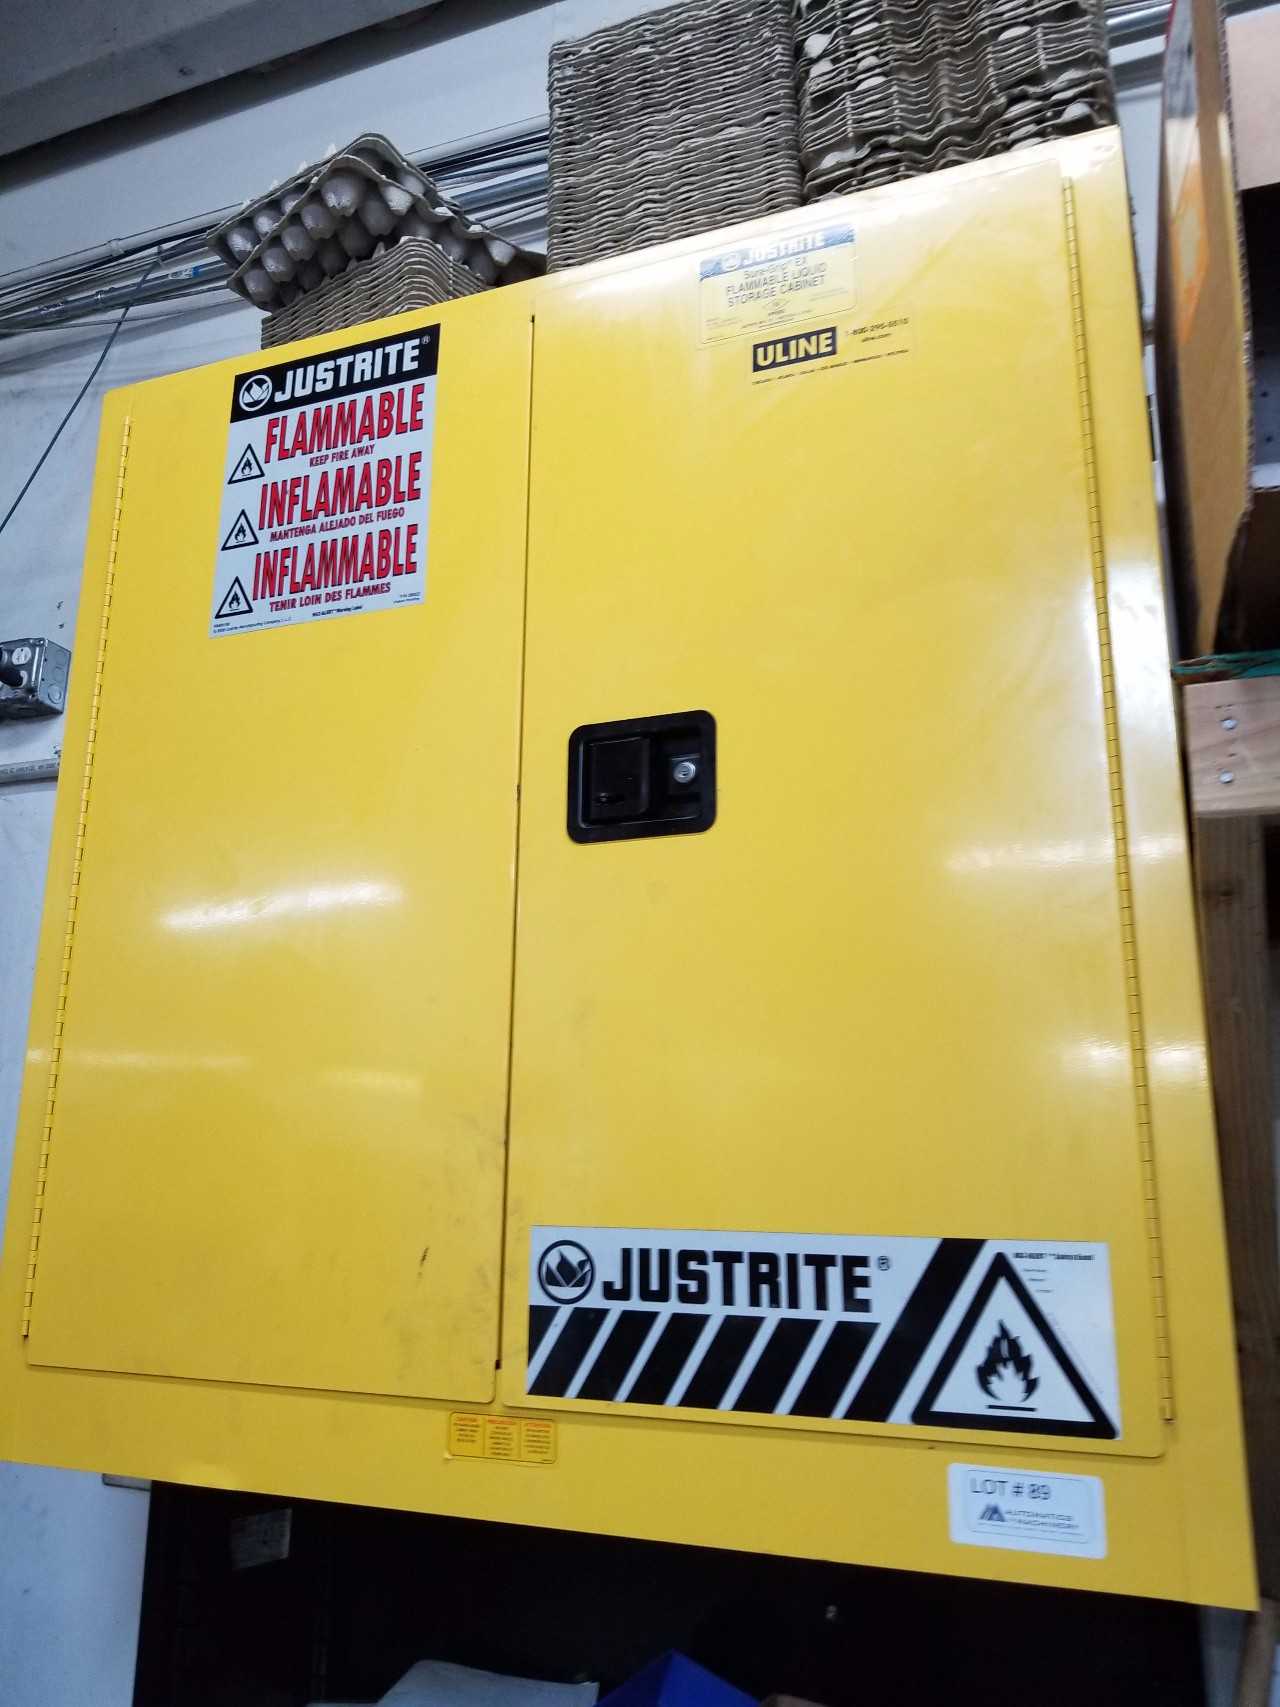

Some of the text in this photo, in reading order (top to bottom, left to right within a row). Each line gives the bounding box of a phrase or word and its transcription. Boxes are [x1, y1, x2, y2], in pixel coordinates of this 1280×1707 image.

[727, 272, 788, 294] FLAMMABLE
[792, 262, 827, 281] LIQUID
[728, 287, 776, 307] STORAGE
[781, 275, 825, 295] CABINET
[756, 331, 833, 367] ULINE
[264, 382, 425, 464] FLAMMABLE
[309, 444, 375, 468] KEEP FIRE AWAY
[258, 451, 422, 531] INFLAMABLE
[270, 507, 405, 542] MANTENGA ALEJADO DEL FUEGO
[252, 523, 418, 601] INFLAMMABLE
[269, 598, 297, 613] TENIR
[299, 594, 322, 608] LOIN
[324, 590, 343, 604] DES
[345, 581, 391, 600] FLAMMES
[969, 1477, 1008, 1496] LOT
